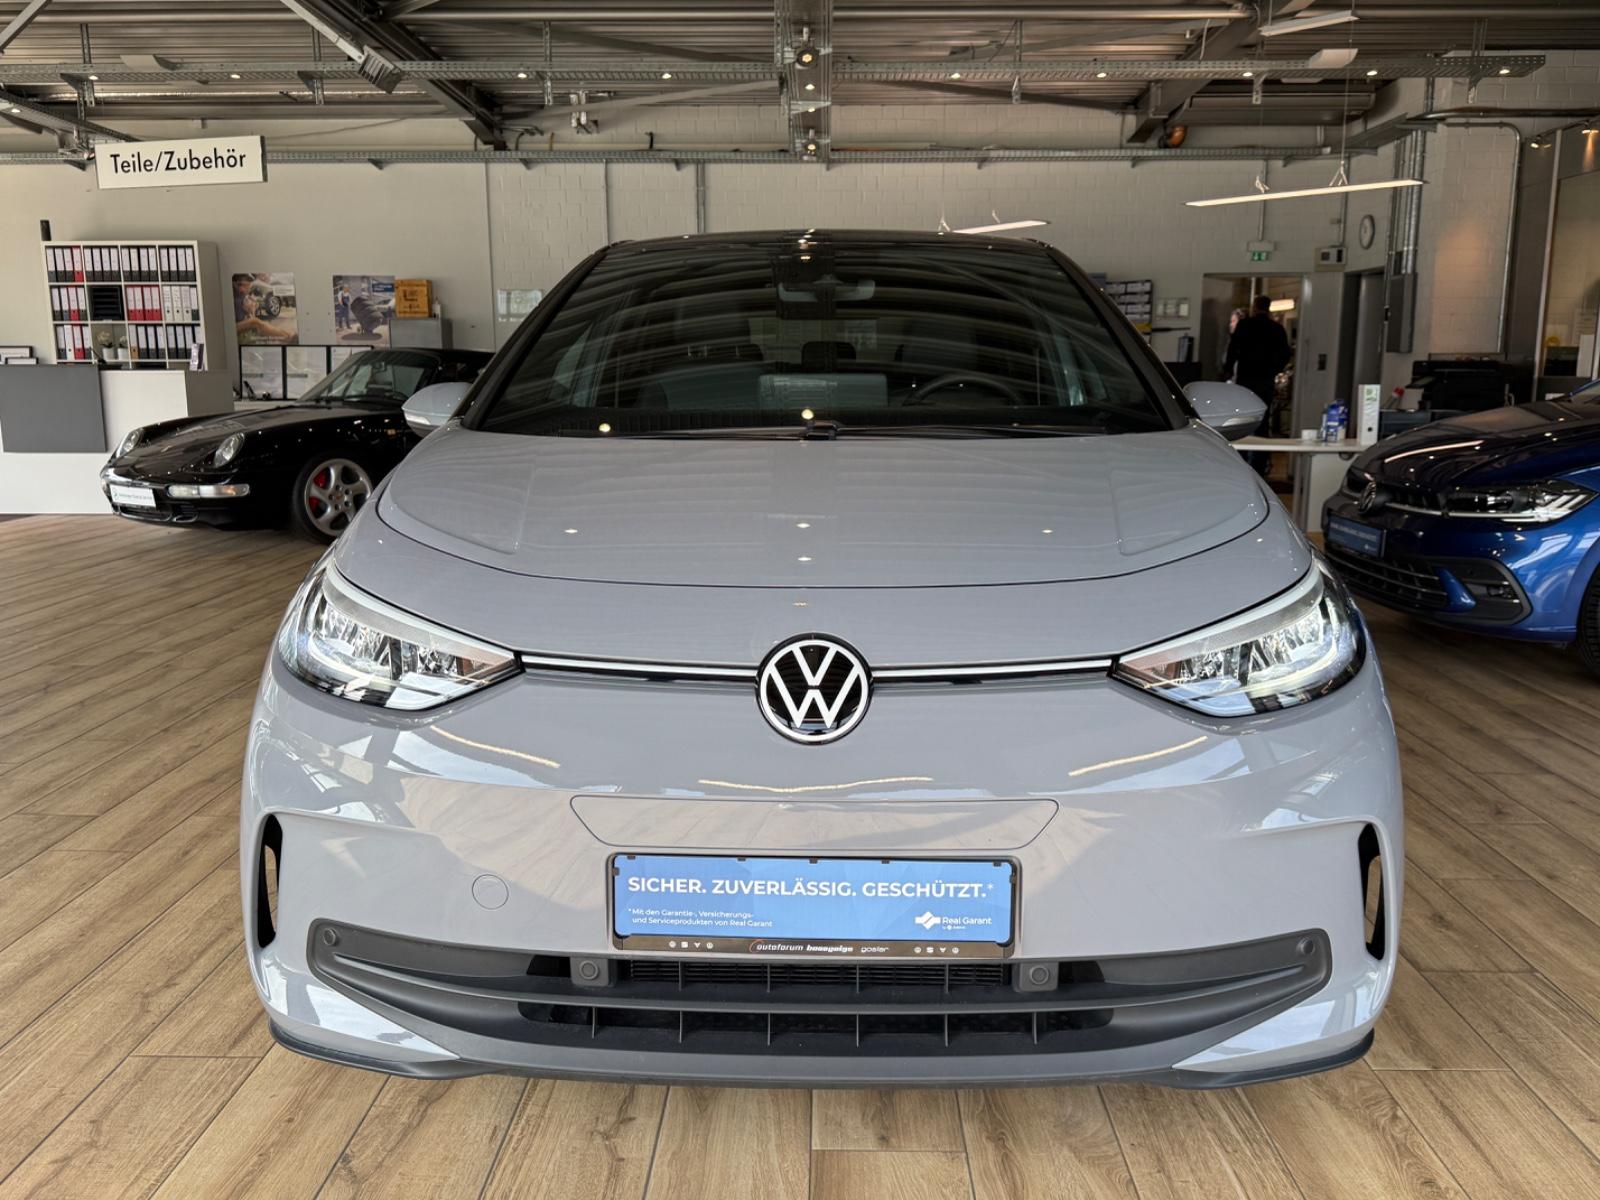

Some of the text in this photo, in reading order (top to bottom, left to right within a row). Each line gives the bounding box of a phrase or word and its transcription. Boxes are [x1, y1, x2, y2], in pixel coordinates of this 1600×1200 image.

[110, 147, 246, 174] Teile/Zubehör
[764, 641, 865, 731] VW
[628, 877, 707, 893] SICHER.
[712, 877, 857, 896] ZUVERLÄSSIG.
[698, 911, 755, 920] Versicherungs-
[942, 916, 992, 925] Real Garant
[648, 918, 714, 926] Serviceprodukten
[730, 919, 746, 927] Real
[746, 920, 773, 928] Garant
